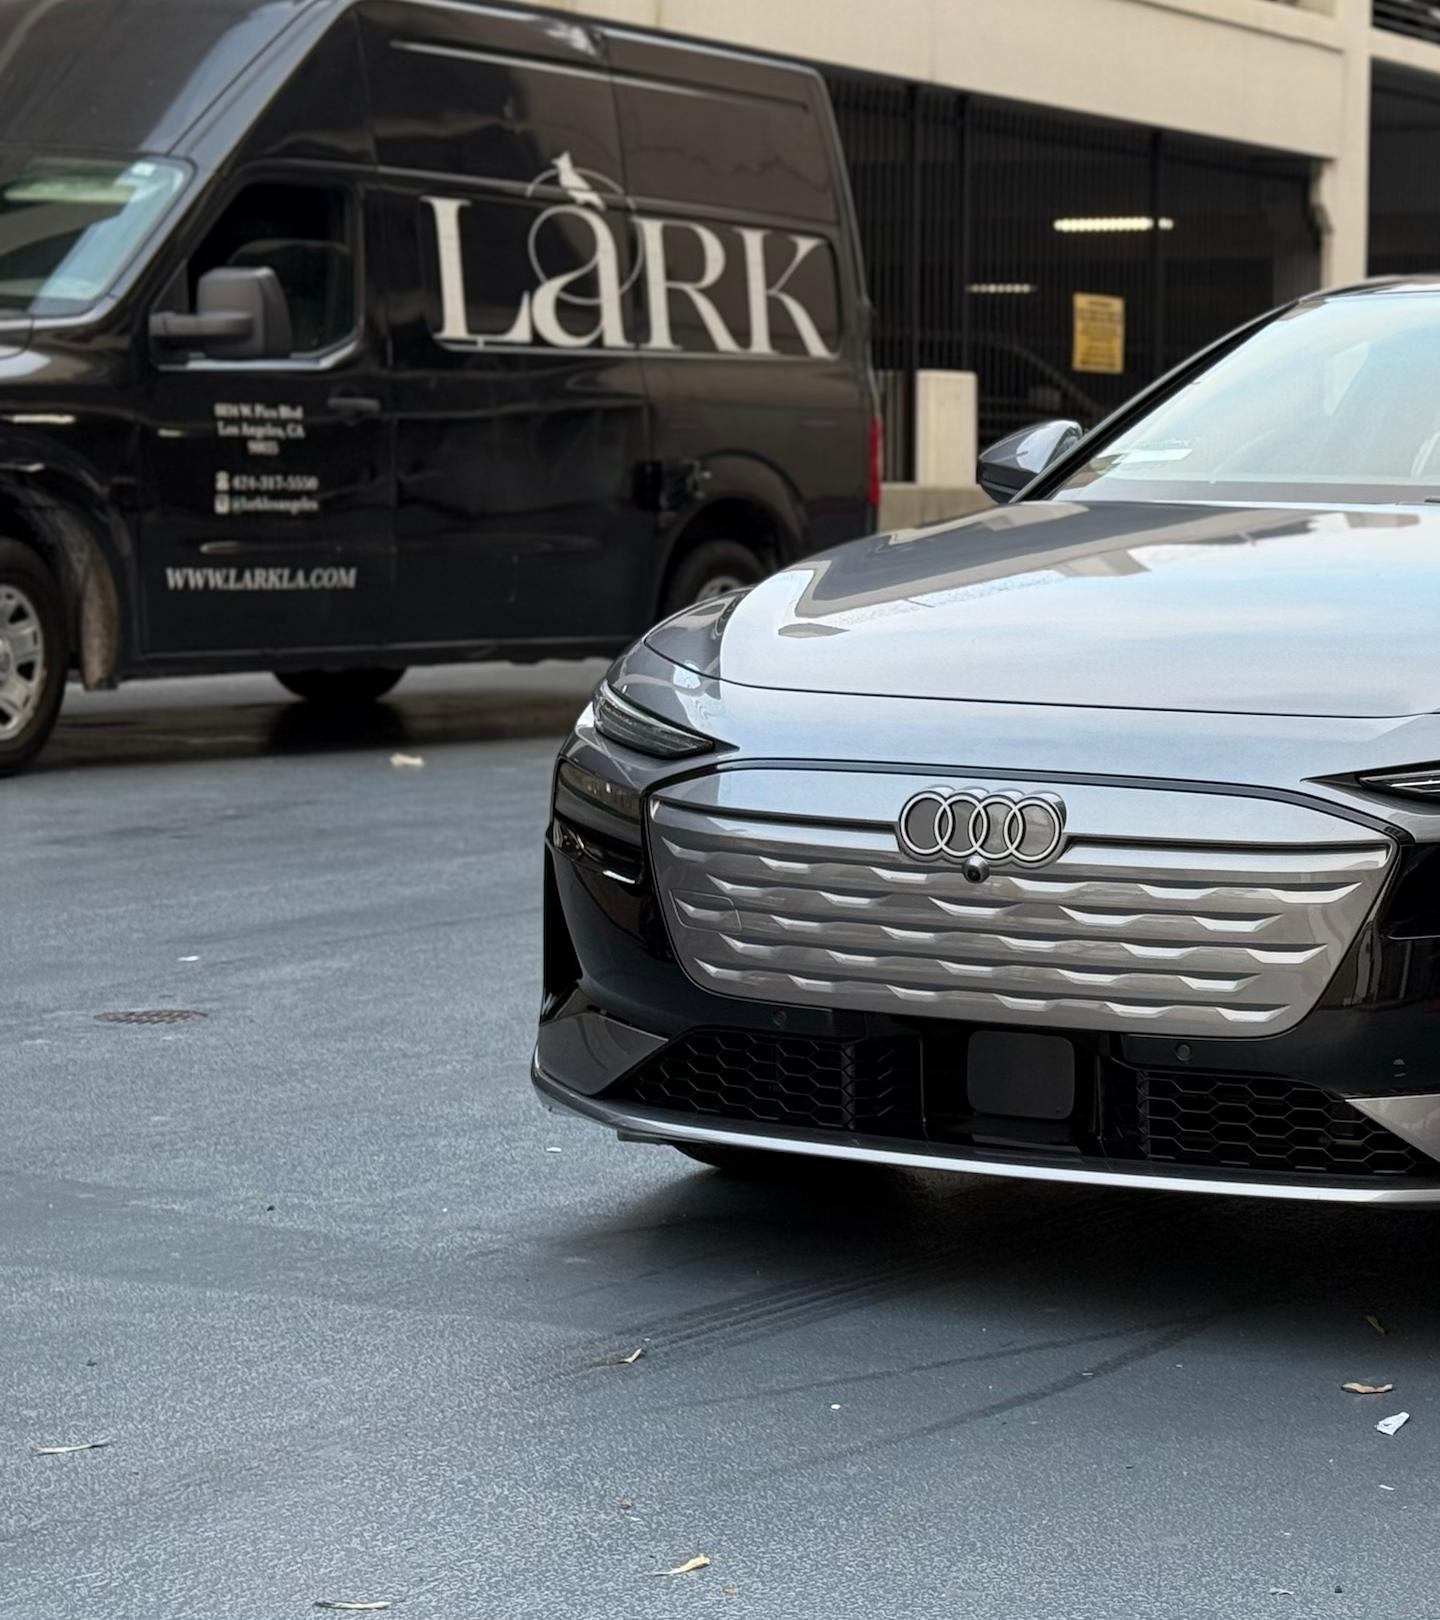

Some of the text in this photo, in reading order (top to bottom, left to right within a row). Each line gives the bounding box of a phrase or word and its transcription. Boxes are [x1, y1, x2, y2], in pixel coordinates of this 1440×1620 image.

[217, 420, 240, 436] Los
[286, 422, 306, 438] CA
[165, 566, 357, 590] WWW.LARKLA.COM
